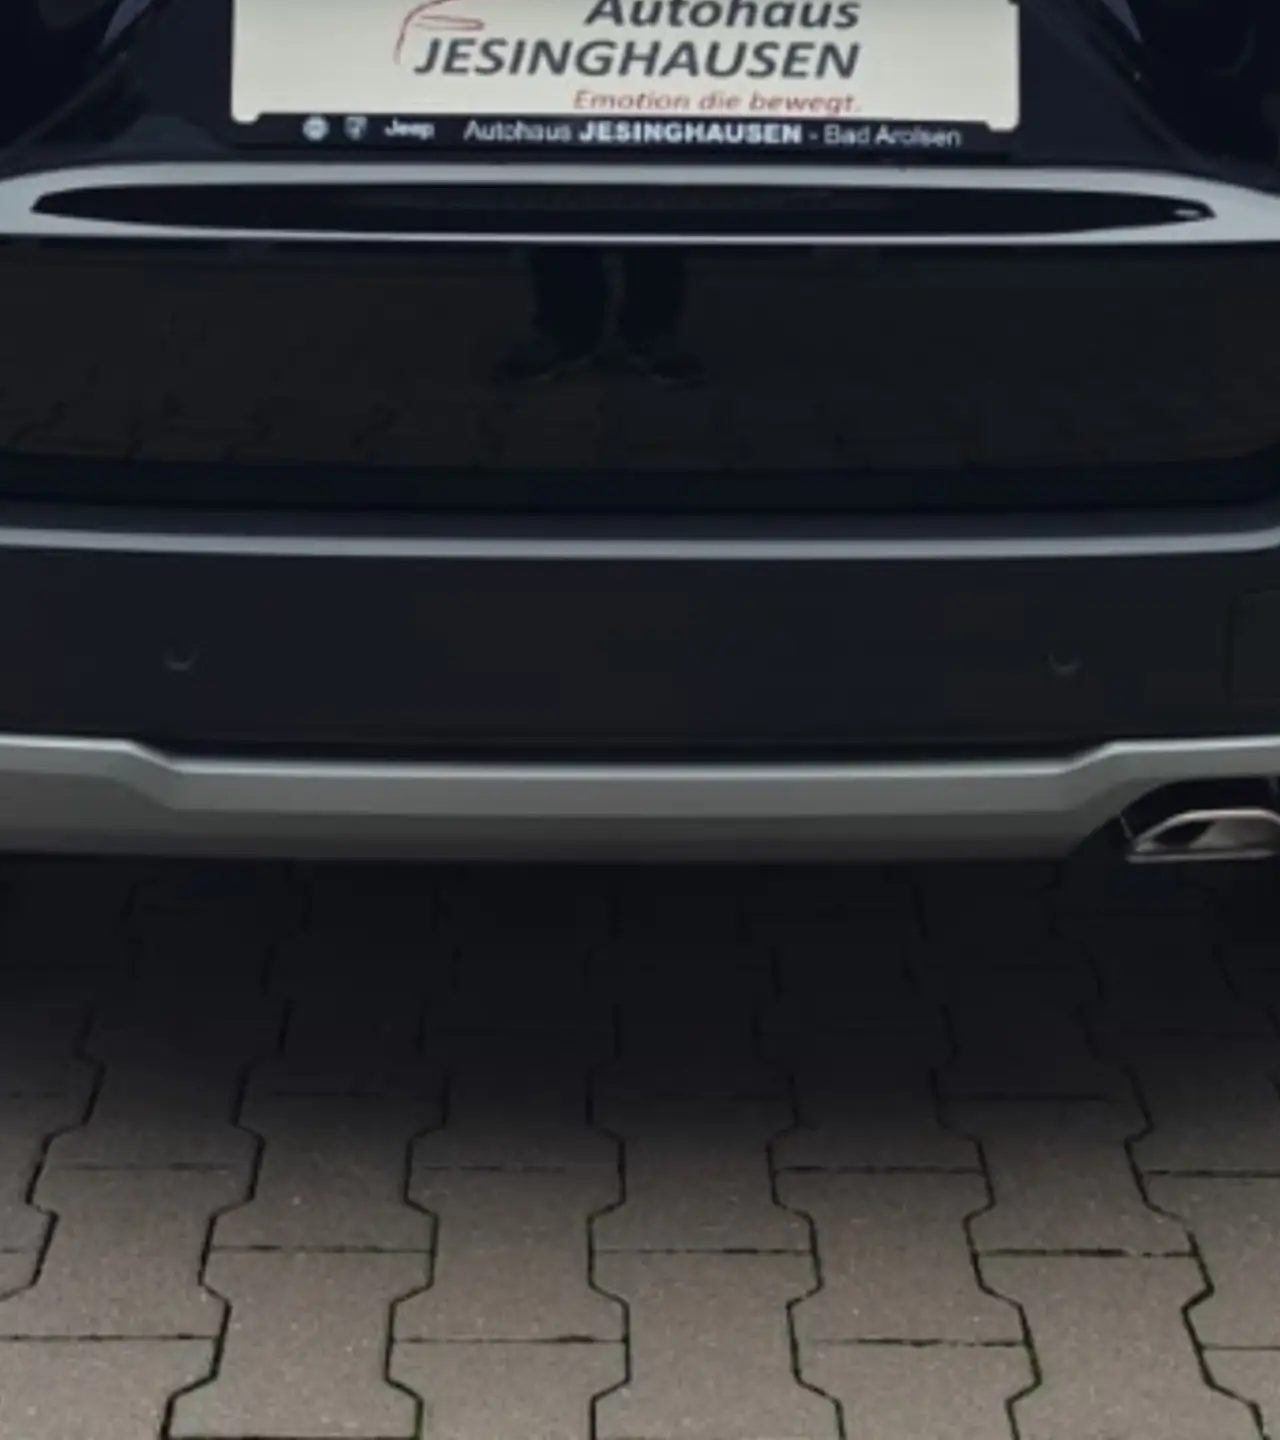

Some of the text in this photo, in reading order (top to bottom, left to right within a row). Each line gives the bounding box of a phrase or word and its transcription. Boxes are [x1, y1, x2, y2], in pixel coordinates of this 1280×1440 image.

[413, 37, 860, 80] JESINGHAUSEN
[573, 89, 862, 115] Emotion die bewegt.
[384, 117, 435, 139] Jeep
[463, 119, 571, 142] Autohaus
[578, 120, 803, 145] JESINGHAUSEN
[824, 124, 871, 146] Bad
